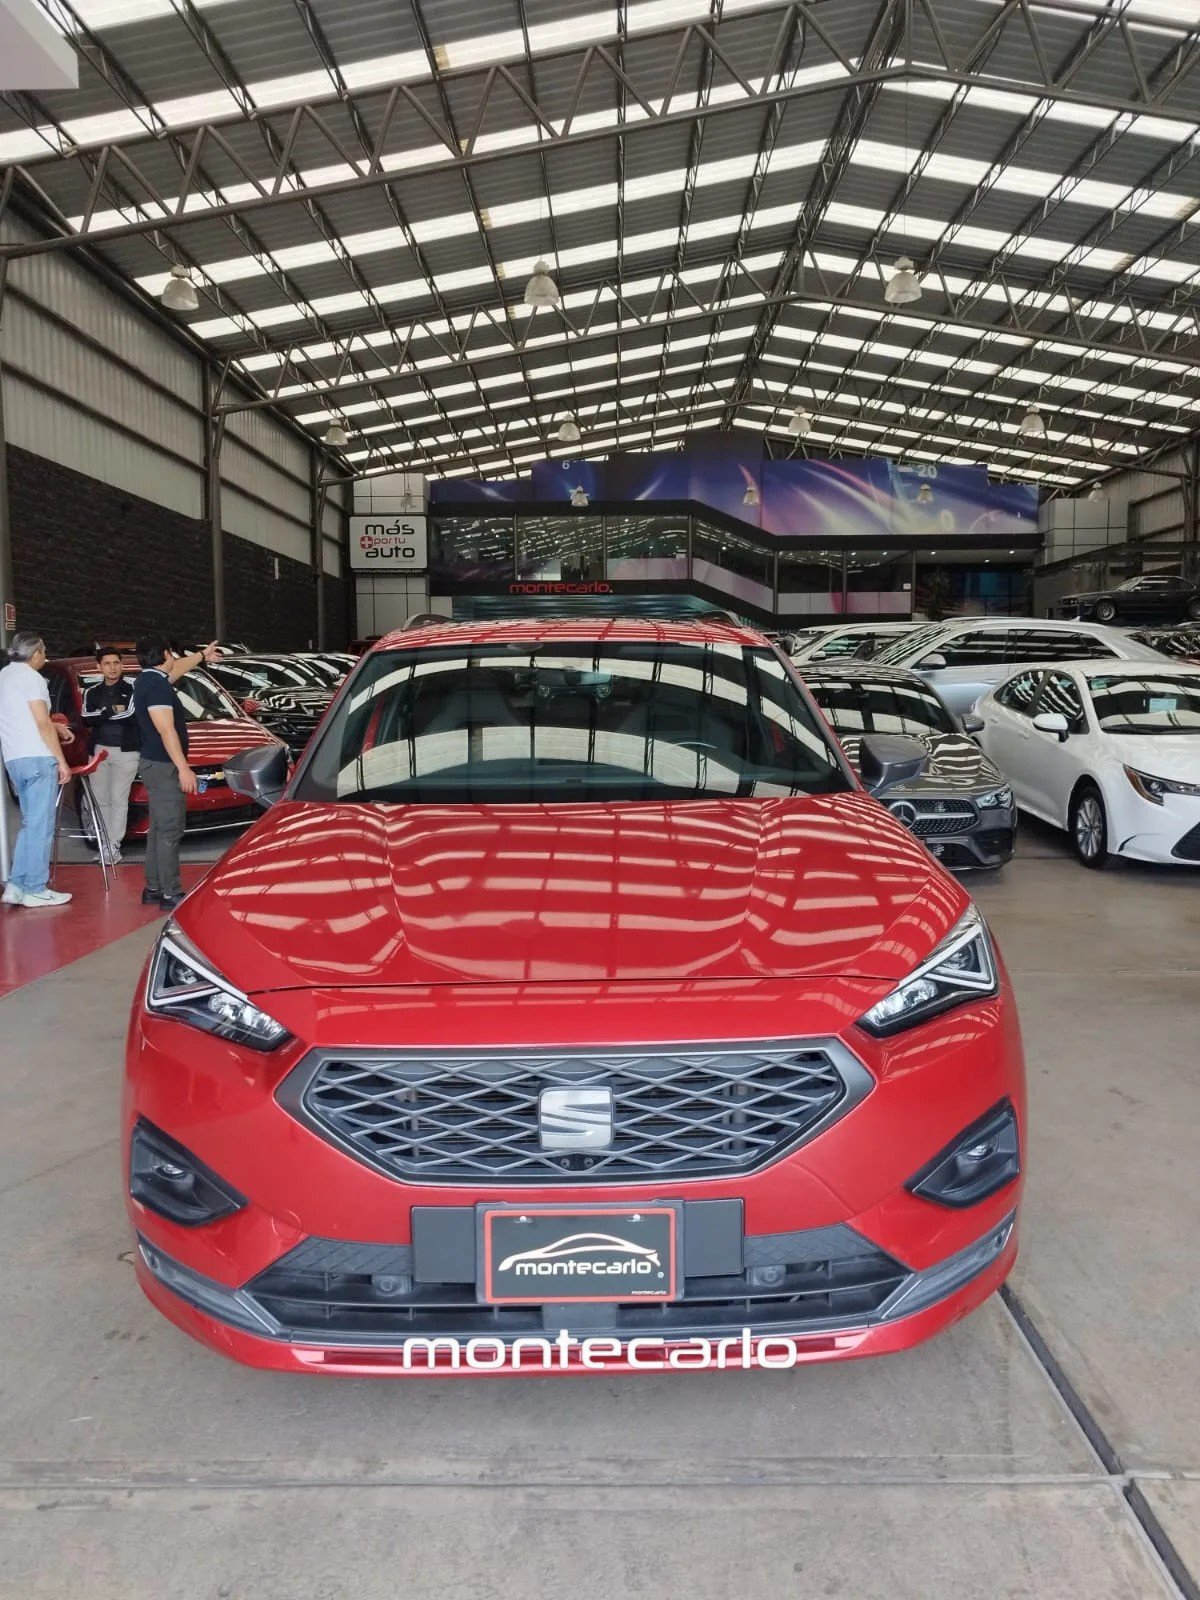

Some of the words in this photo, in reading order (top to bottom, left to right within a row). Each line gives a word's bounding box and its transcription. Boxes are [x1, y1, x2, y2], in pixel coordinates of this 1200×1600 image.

[918, 465, 937, 479] 20
[365, 519, 415, 535] más
[365, 546, 415, 558] auto
[515, 1259, 652, 1276] montecarlo
